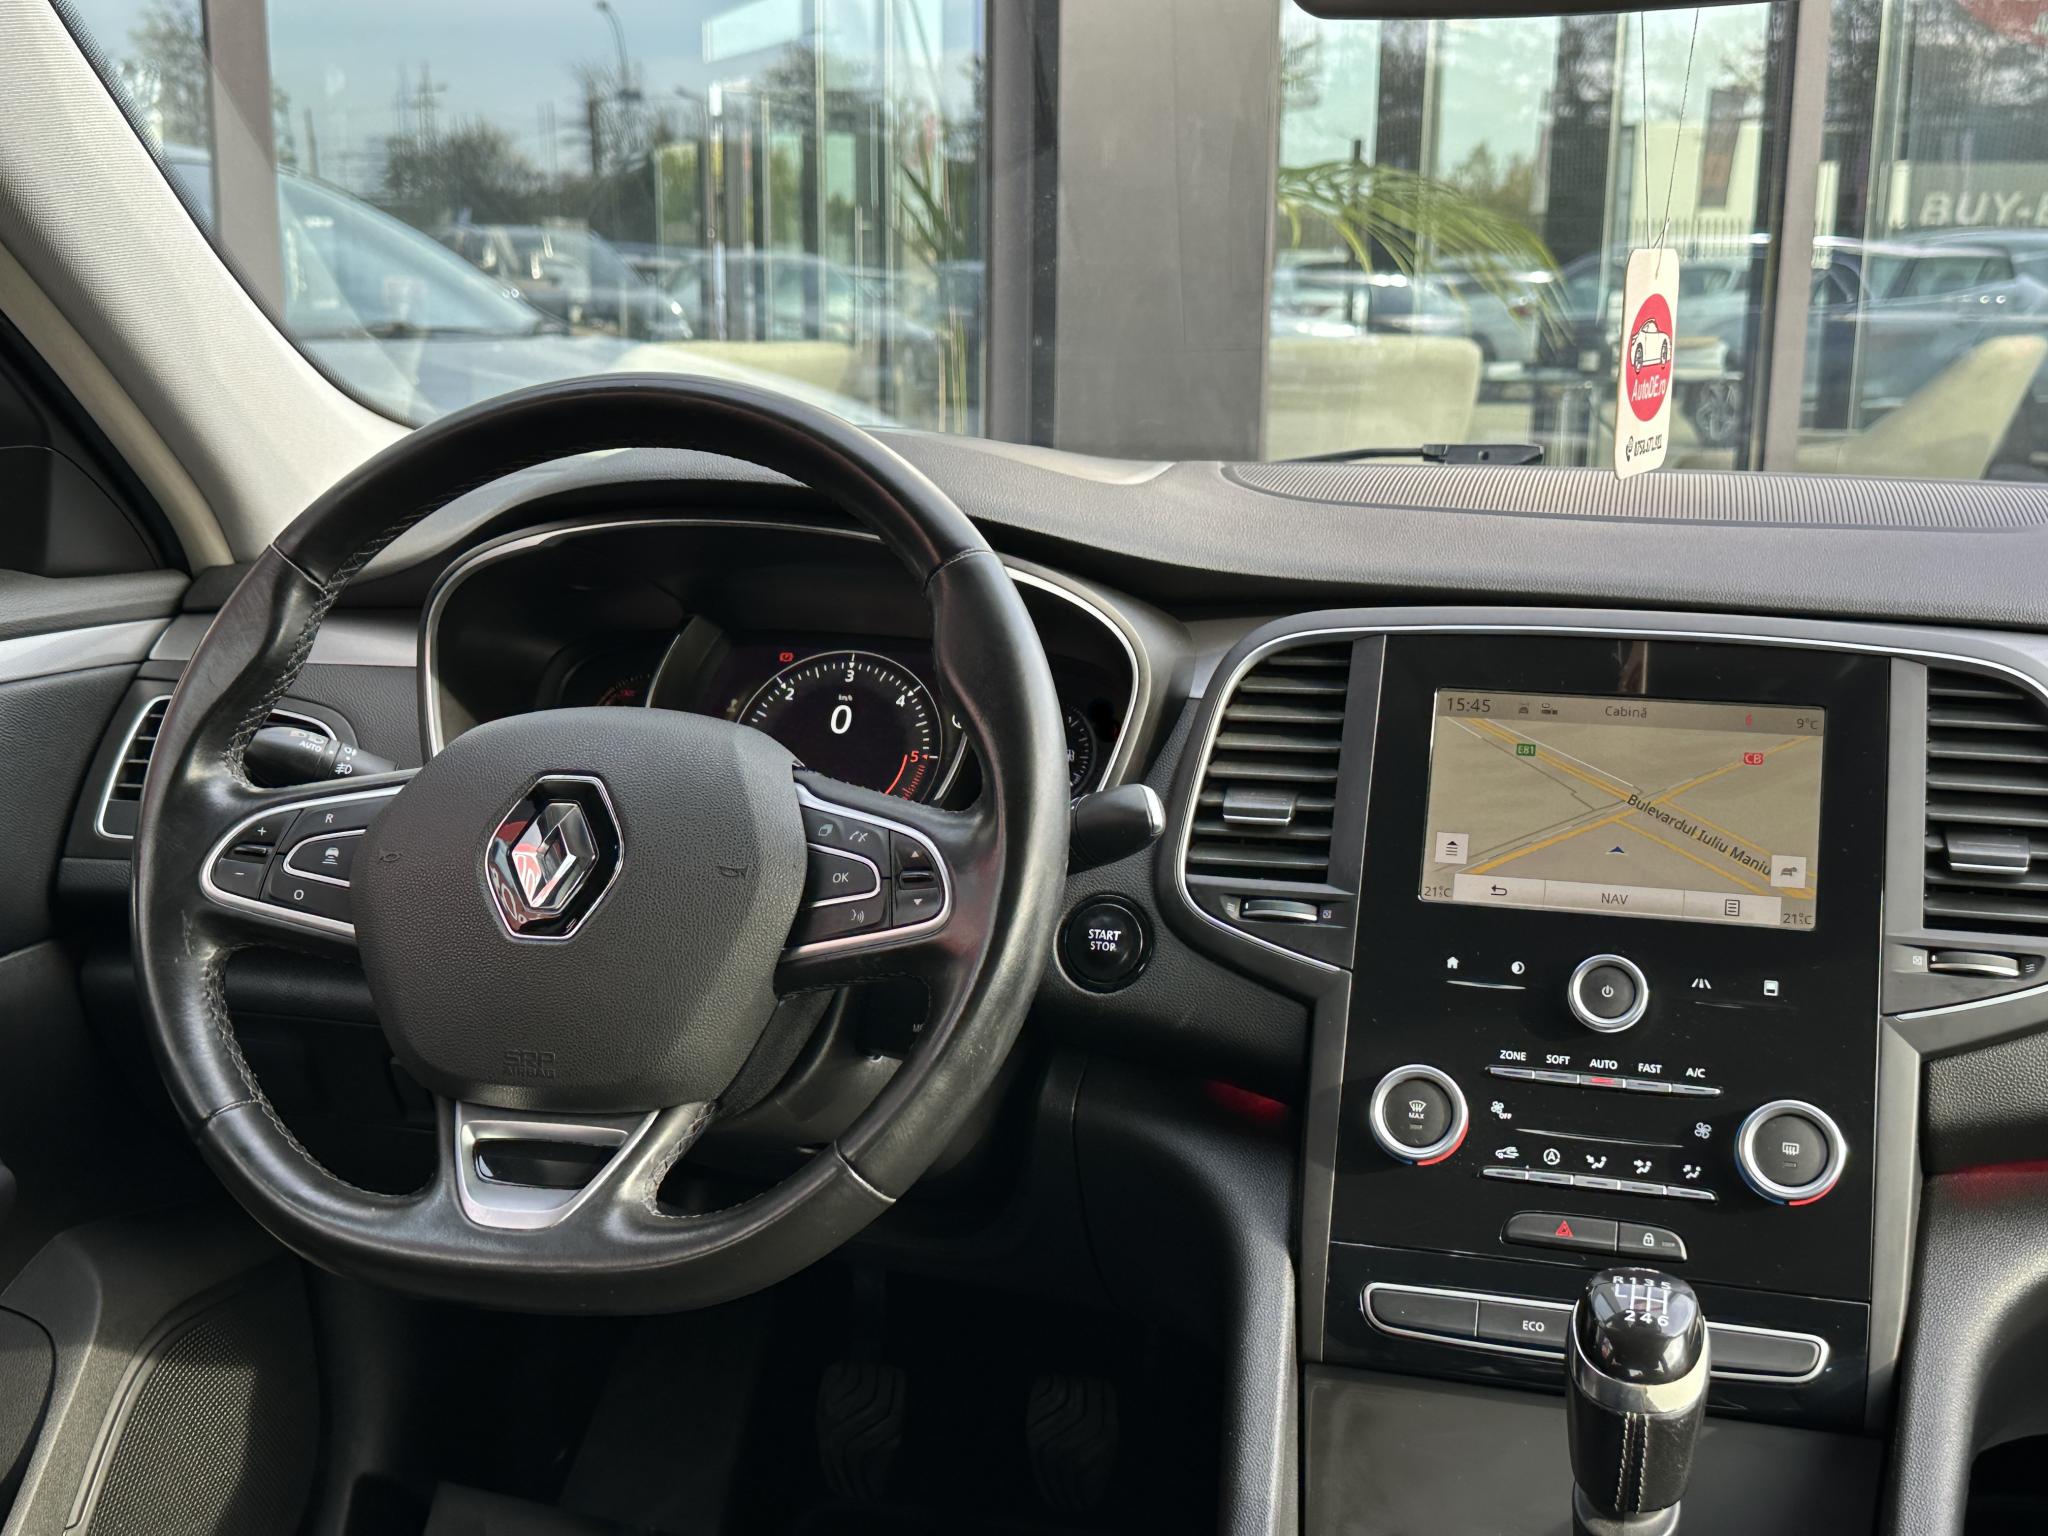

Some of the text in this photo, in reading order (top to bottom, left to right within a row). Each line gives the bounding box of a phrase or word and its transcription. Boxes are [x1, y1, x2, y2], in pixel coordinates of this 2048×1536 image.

[1631, 374, 1667, 401] AutoDE.ro
[844, 669, 855, 683] 3
[784, 687, 795, 700] 2
[895, 694, 906, 707] 4
[1446, 697, 1491, 714] 15:45
[830, 704, 853, 735] 0
[1796, 717, 1818, 730] 9°C
[298, 740, 322, 753] AUTO
[910, 750, 920, 763] 5
[1745, 753, 1762, 764] CB
[325, 813, 335, 823] R
[1626, 793, 1771, 876] Bulevardul Iuliu Maniu
[832, 872, 849, 883] OK
[1600, 892, 1630, 906] NAV
[1088, 928, 1121, 941] START
[1090, 940, 1117, 951] STOP
[1499, 1049, 1527, 1062] ZONE
[1545, 1053, 1571, 1066] SOFT
[1589, 1058, 1618, 1070] AUTO
[1637, 1061, 1662, 1074] FAST
[1685, 1066, 1706, 1079] A/C
[1408, 1112, 1425, 1120] MAX
[1498, 1112, 1512, 1120] OFF
[1612, 1275, 1672, 1290] R 1 3 5
[1624, 1309, 1669, 1327] 2 4 6
[1522, 1319, 1545, 1333] ECO
